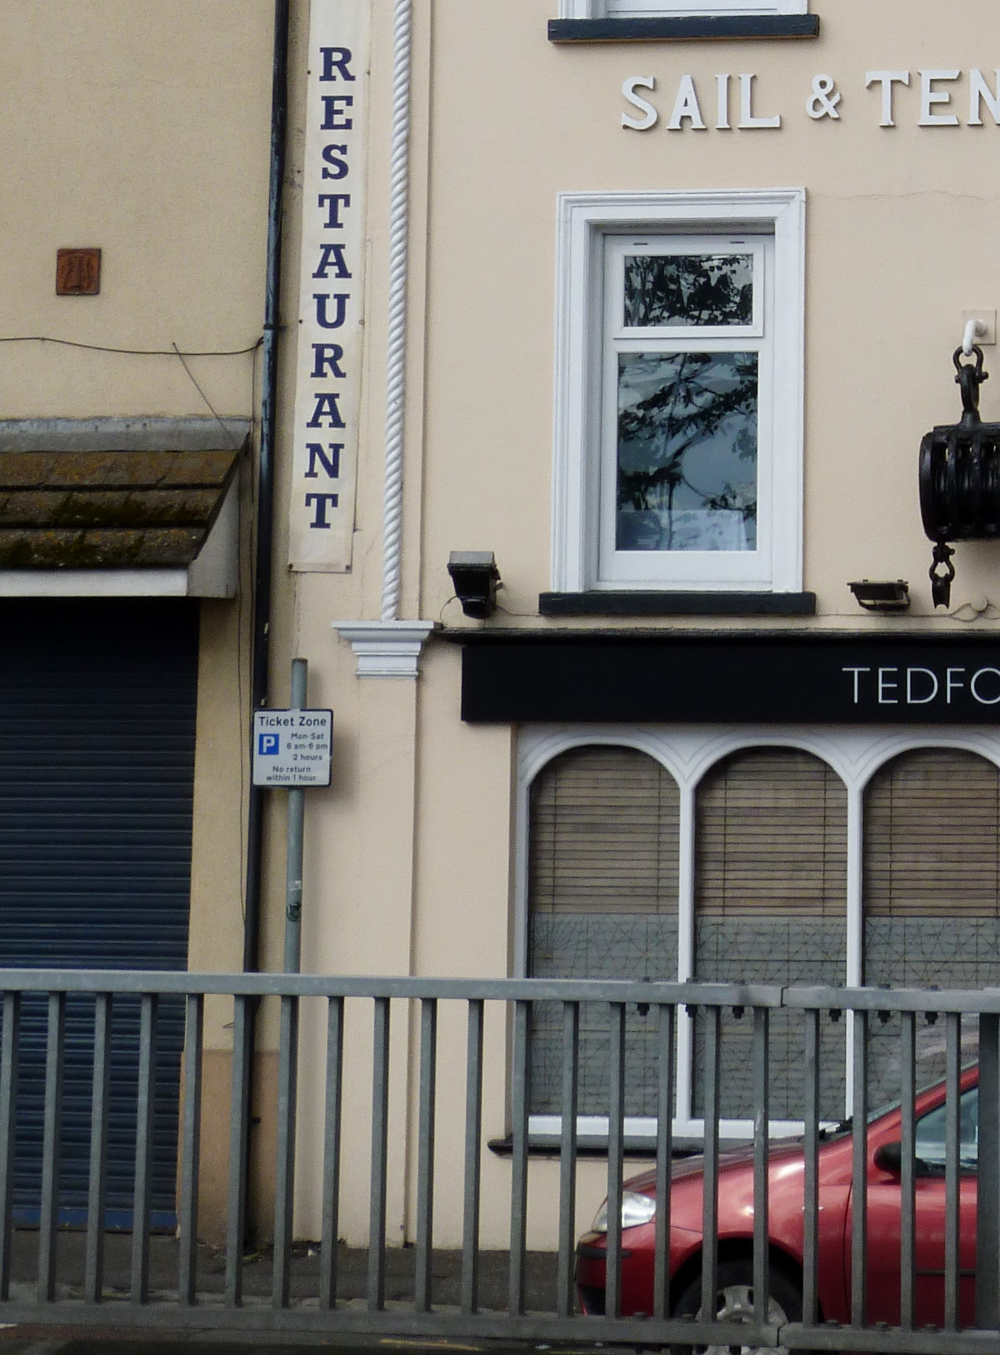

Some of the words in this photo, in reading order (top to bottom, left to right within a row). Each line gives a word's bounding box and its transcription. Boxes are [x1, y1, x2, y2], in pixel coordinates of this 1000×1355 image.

[621, 73, 782, 130] SAIL
[805, 73, 841, 120] &
[303, 46, 356, 530] RESTAURANT
[259, 716, 294, 726] Ticket
[299, 716, 327, 726] Zone
[316, 743, 328, 751] pm
[293, 753, 298, 761] 2
[300, 753, 322, 761] hours
[272, 765, 284, 773] No
[286, 765, 311, 773] return
[299, 774, 316, 782] hour
